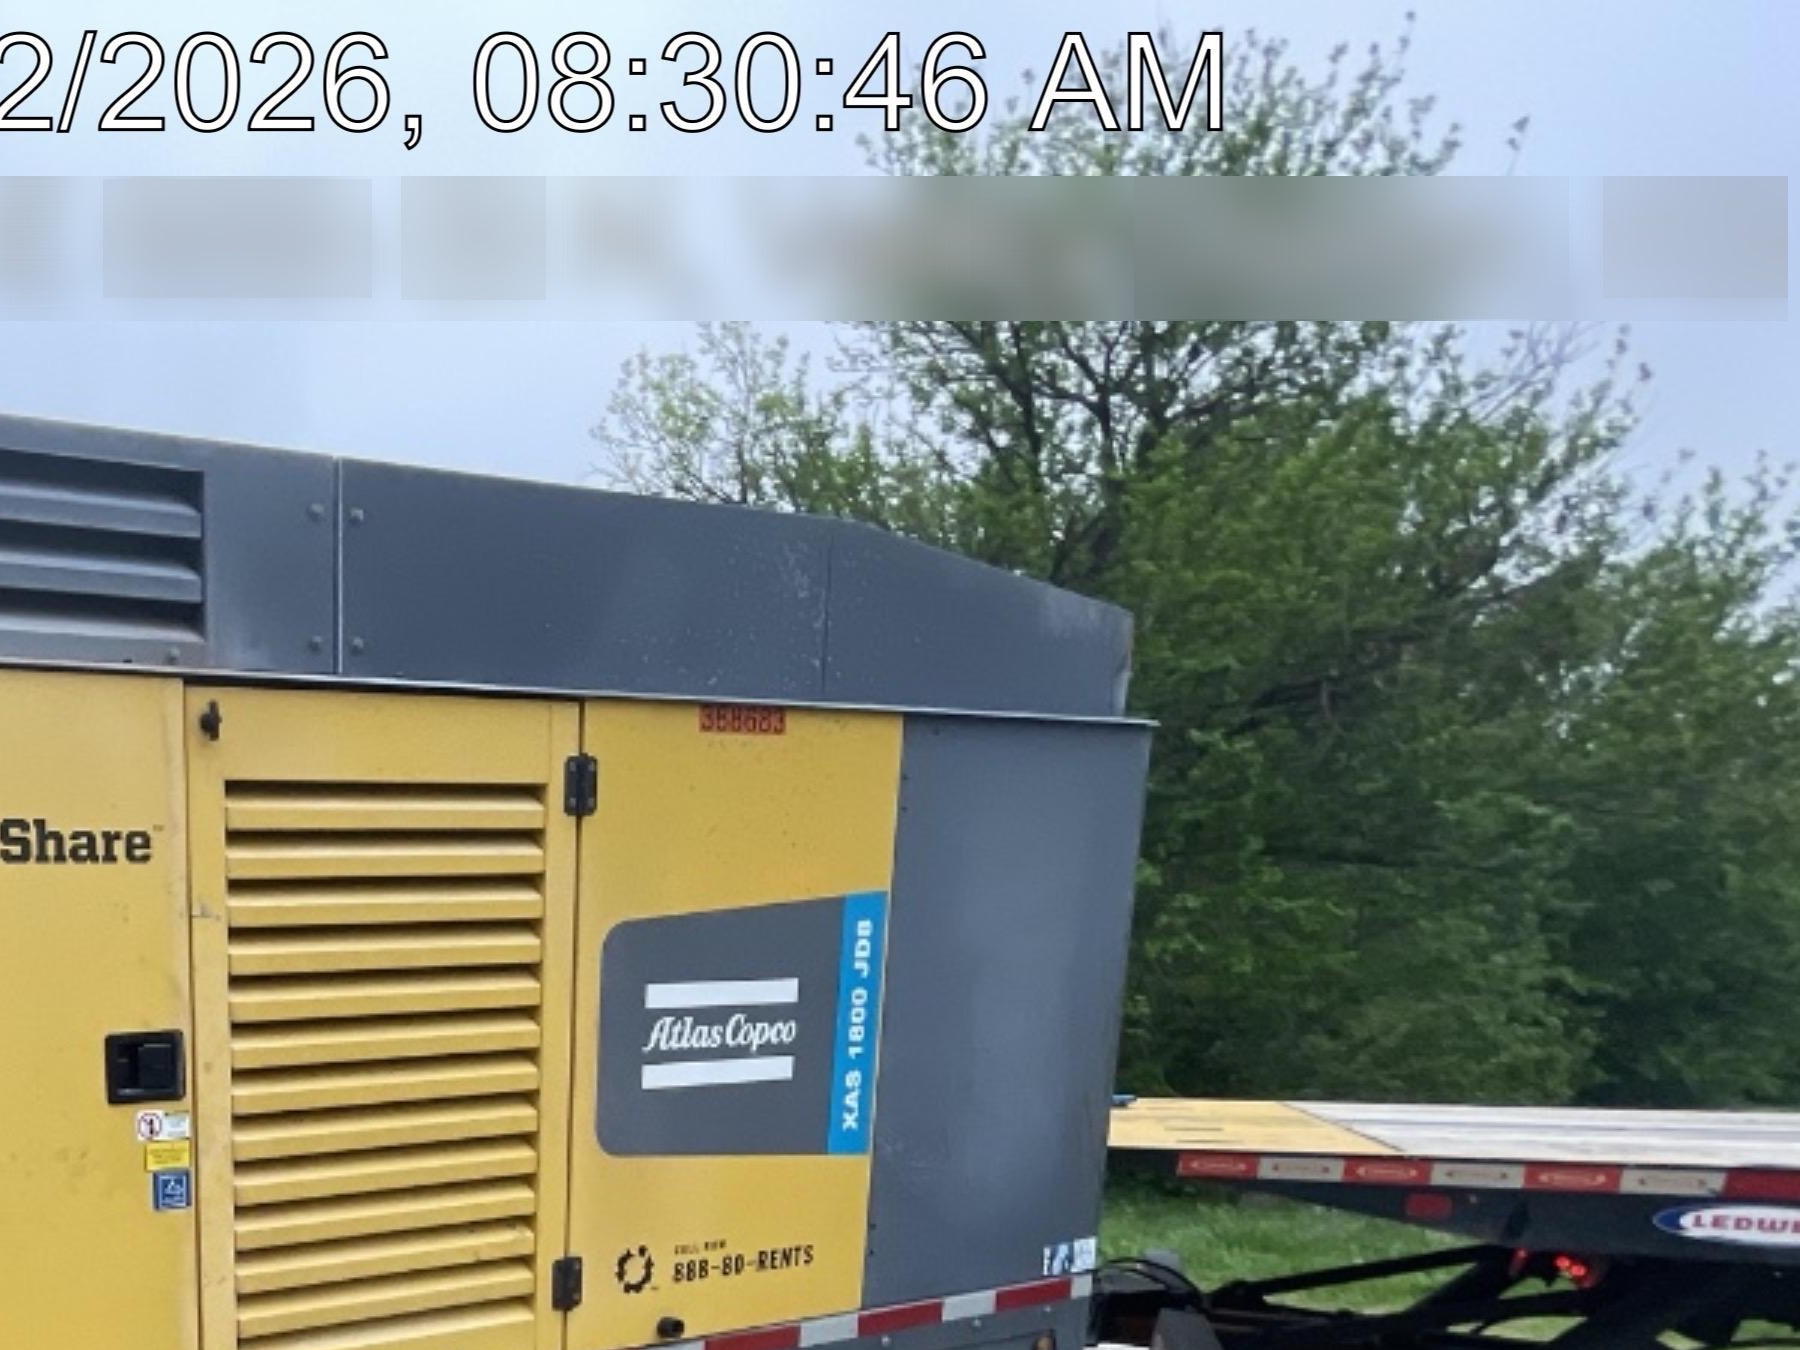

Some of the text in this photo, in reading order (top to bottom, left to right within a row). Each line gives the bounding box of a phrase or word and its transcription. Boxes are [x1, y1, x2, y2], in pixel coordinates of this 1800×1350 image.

[641, 1012, 797, 1053] Atlas Copco
[848, 986, 868, 1060] 1800
[842, 1068, 862, 1131] XAS
